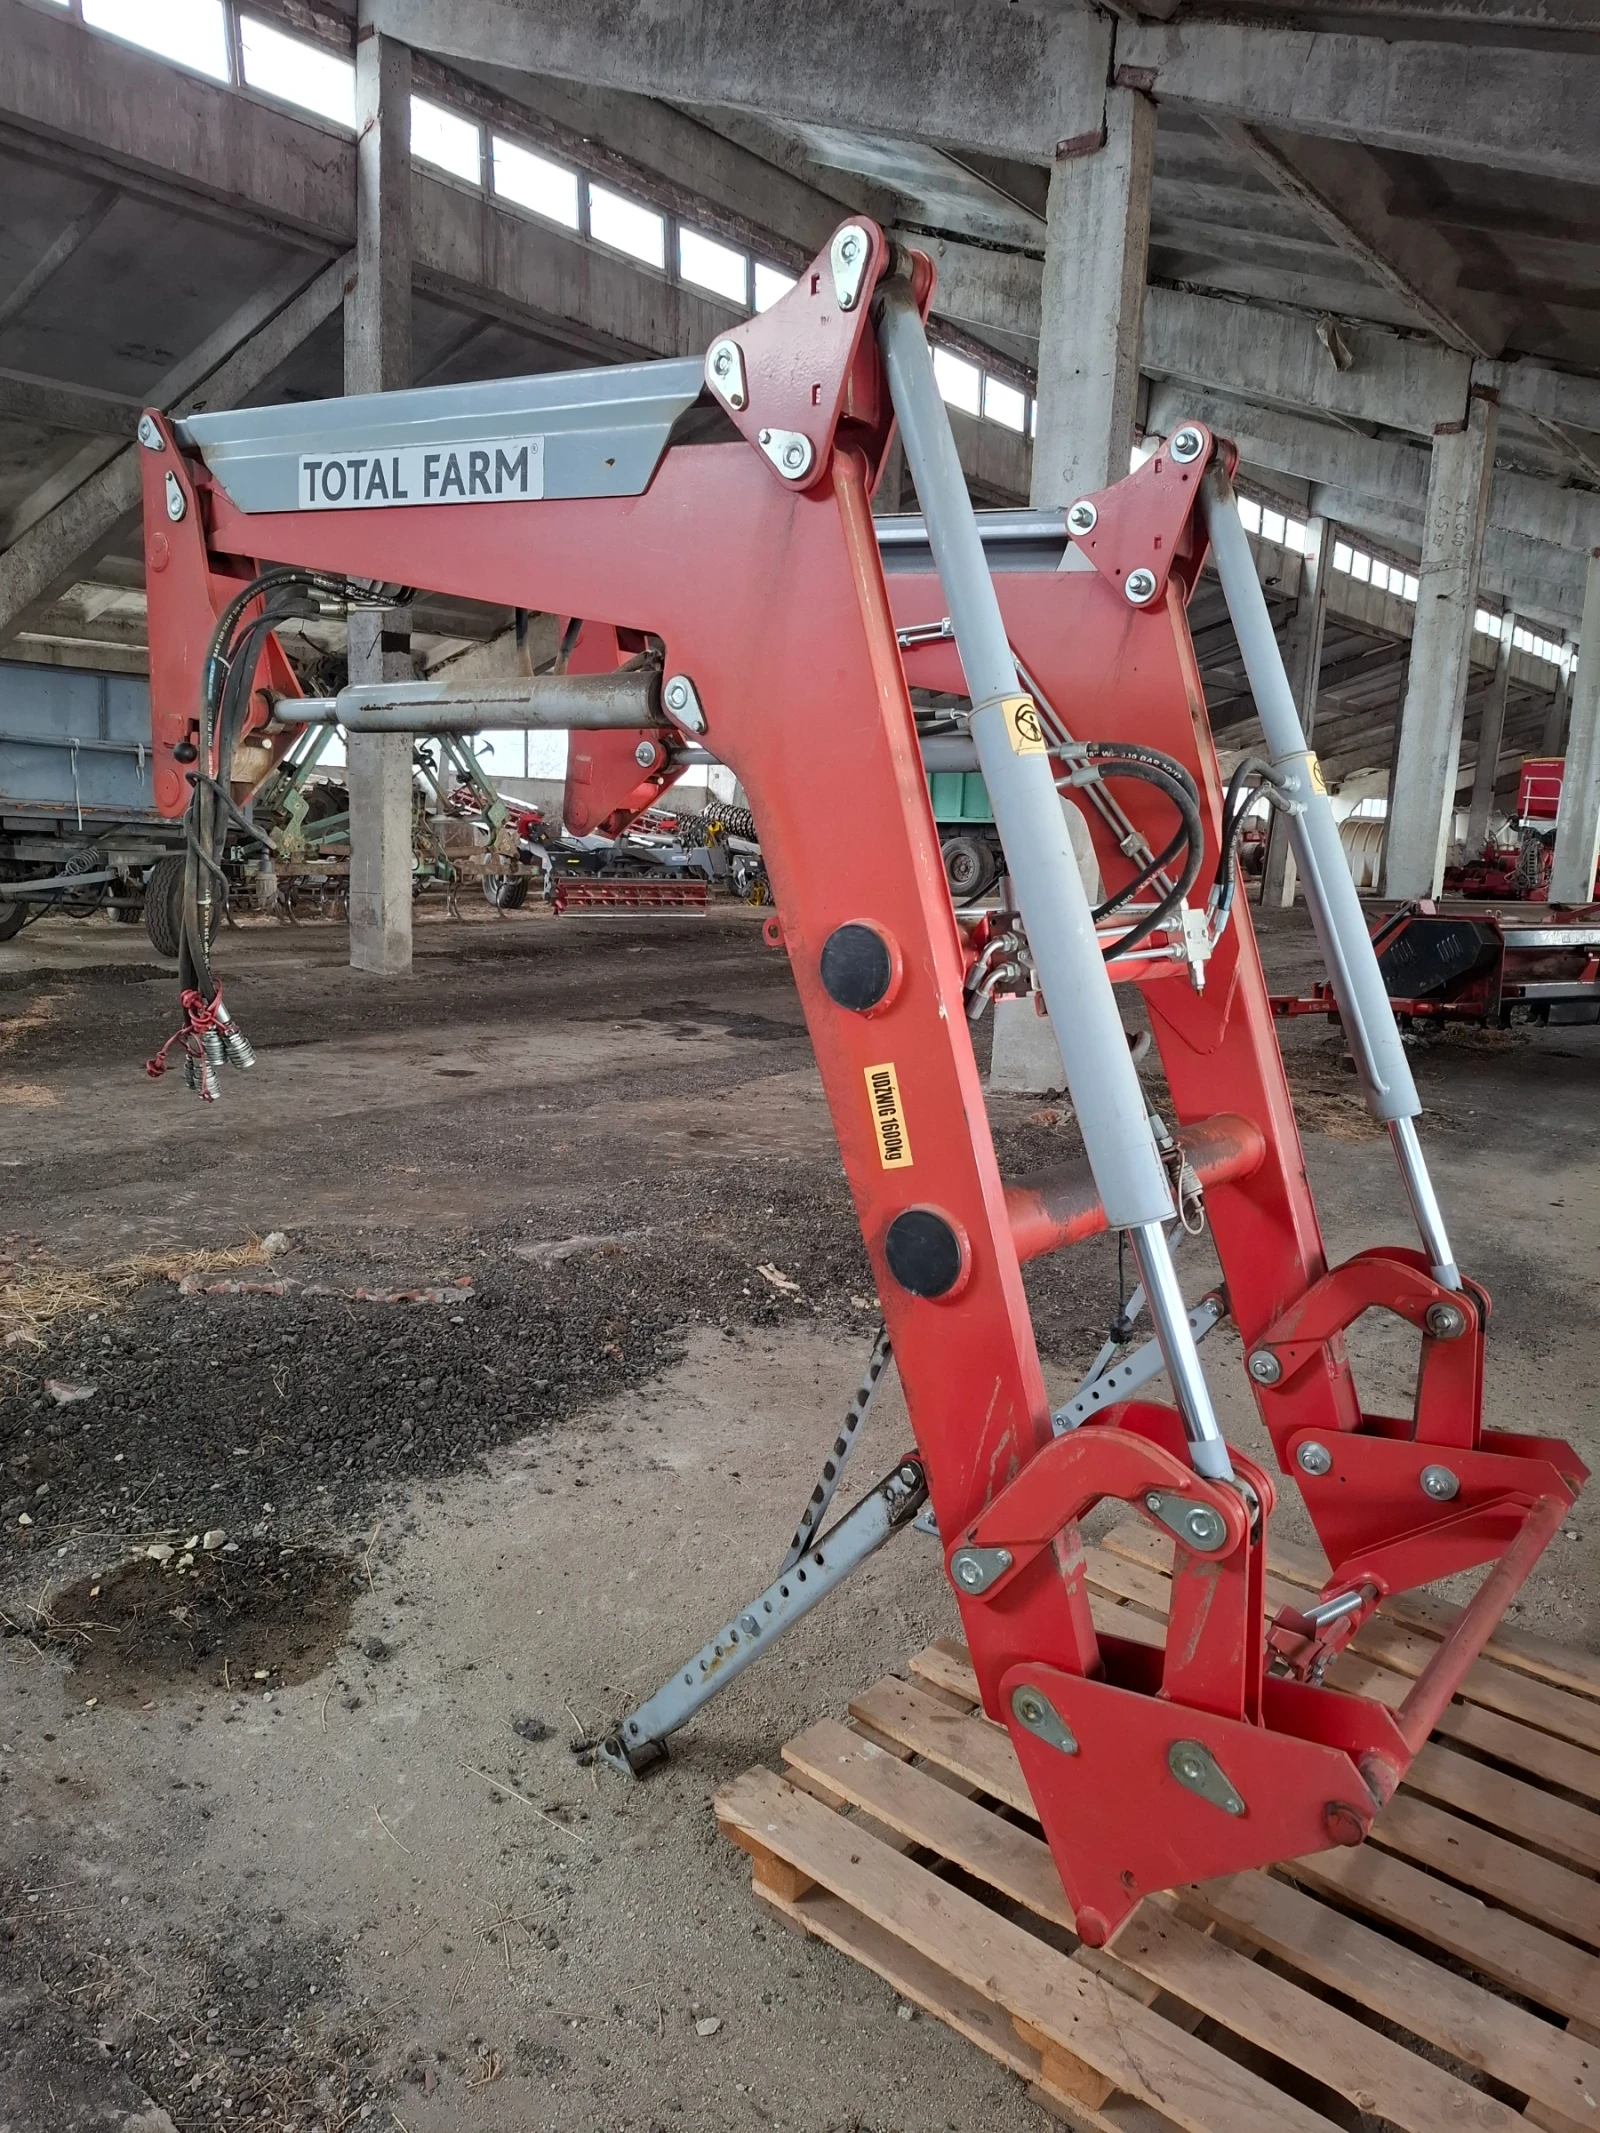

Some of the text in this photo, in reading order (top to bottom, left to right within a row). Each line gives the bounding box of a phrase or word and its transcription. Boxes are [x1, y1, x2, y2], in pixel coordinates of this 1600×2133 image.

[303, 457, 408, 501] TOTAL
[1120, 894, 1134, 906] DIN
[871, 1071, 904, 1161] UDŹWIG 1600kg
